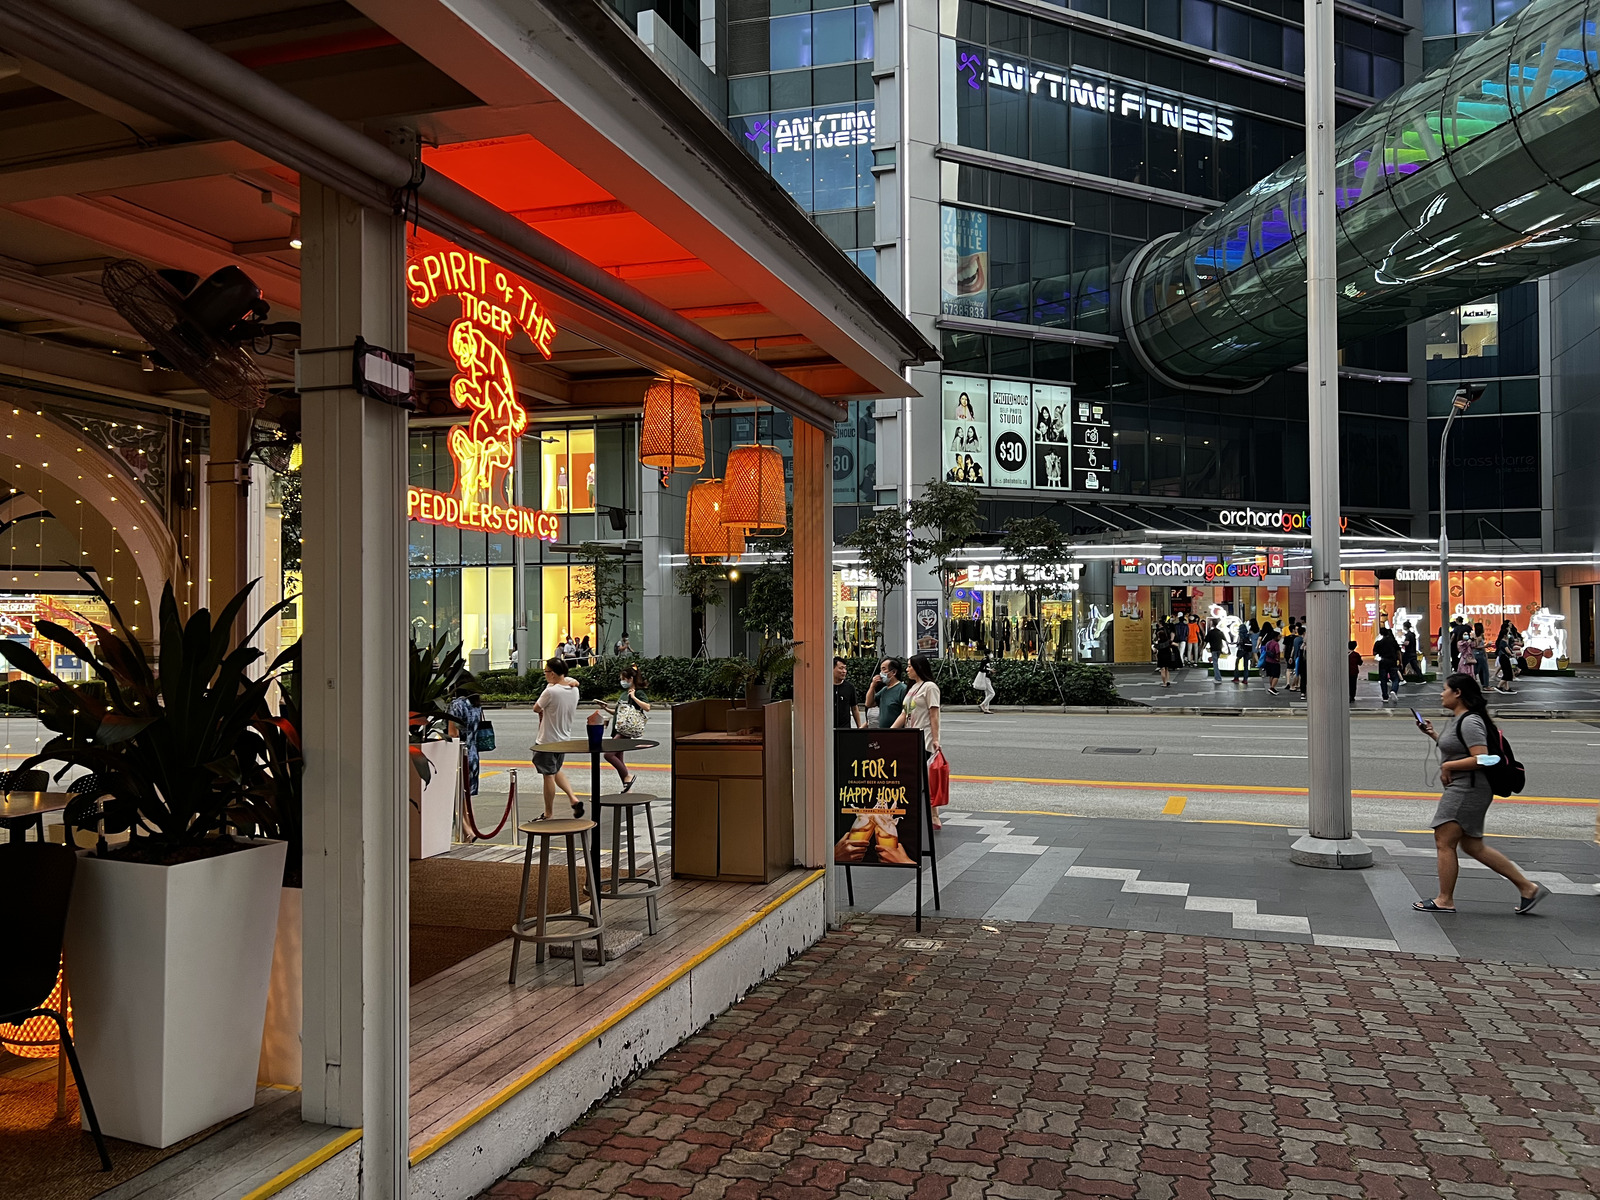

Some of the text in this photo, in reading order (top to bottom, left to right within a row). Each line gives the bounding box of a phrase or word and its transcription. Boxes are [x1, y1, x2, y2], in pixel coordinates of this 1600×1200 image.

[981, 57, 1235, 142] ANYTIME FITNESS
[943, 209, 983, 225] 7 DAYS
[943, 223, 984, 238] BEAUTIFUL
[943, 231, 983, 251] SMILE
[407, 251, 558, 358] SPIRIT OF THE
[458, 291, 513, 337] TIGER
[999, 413, 1023, 425] STUDIO
[999, 441, 1023, 463] $30
[407, 489, 503, 530] PEDDLERS
[505, 508, 535, 536] GIN
[1219, 507, 1348, 533] orchardgaty
[967, 564, 1020, 582] EAST
[1123, 565, 1136, 573] MRT
[1146, 559, 1268, 581] orchardgateway
[1396, 568, 1440, 581] 6IXTY8IGHT
[1455, 603, 1522, 616] 6IXTY8IGHT
[851, 757, 898, 779] 1 FOR 1
[839, 785, 909, 808] HAPPY HOUR
